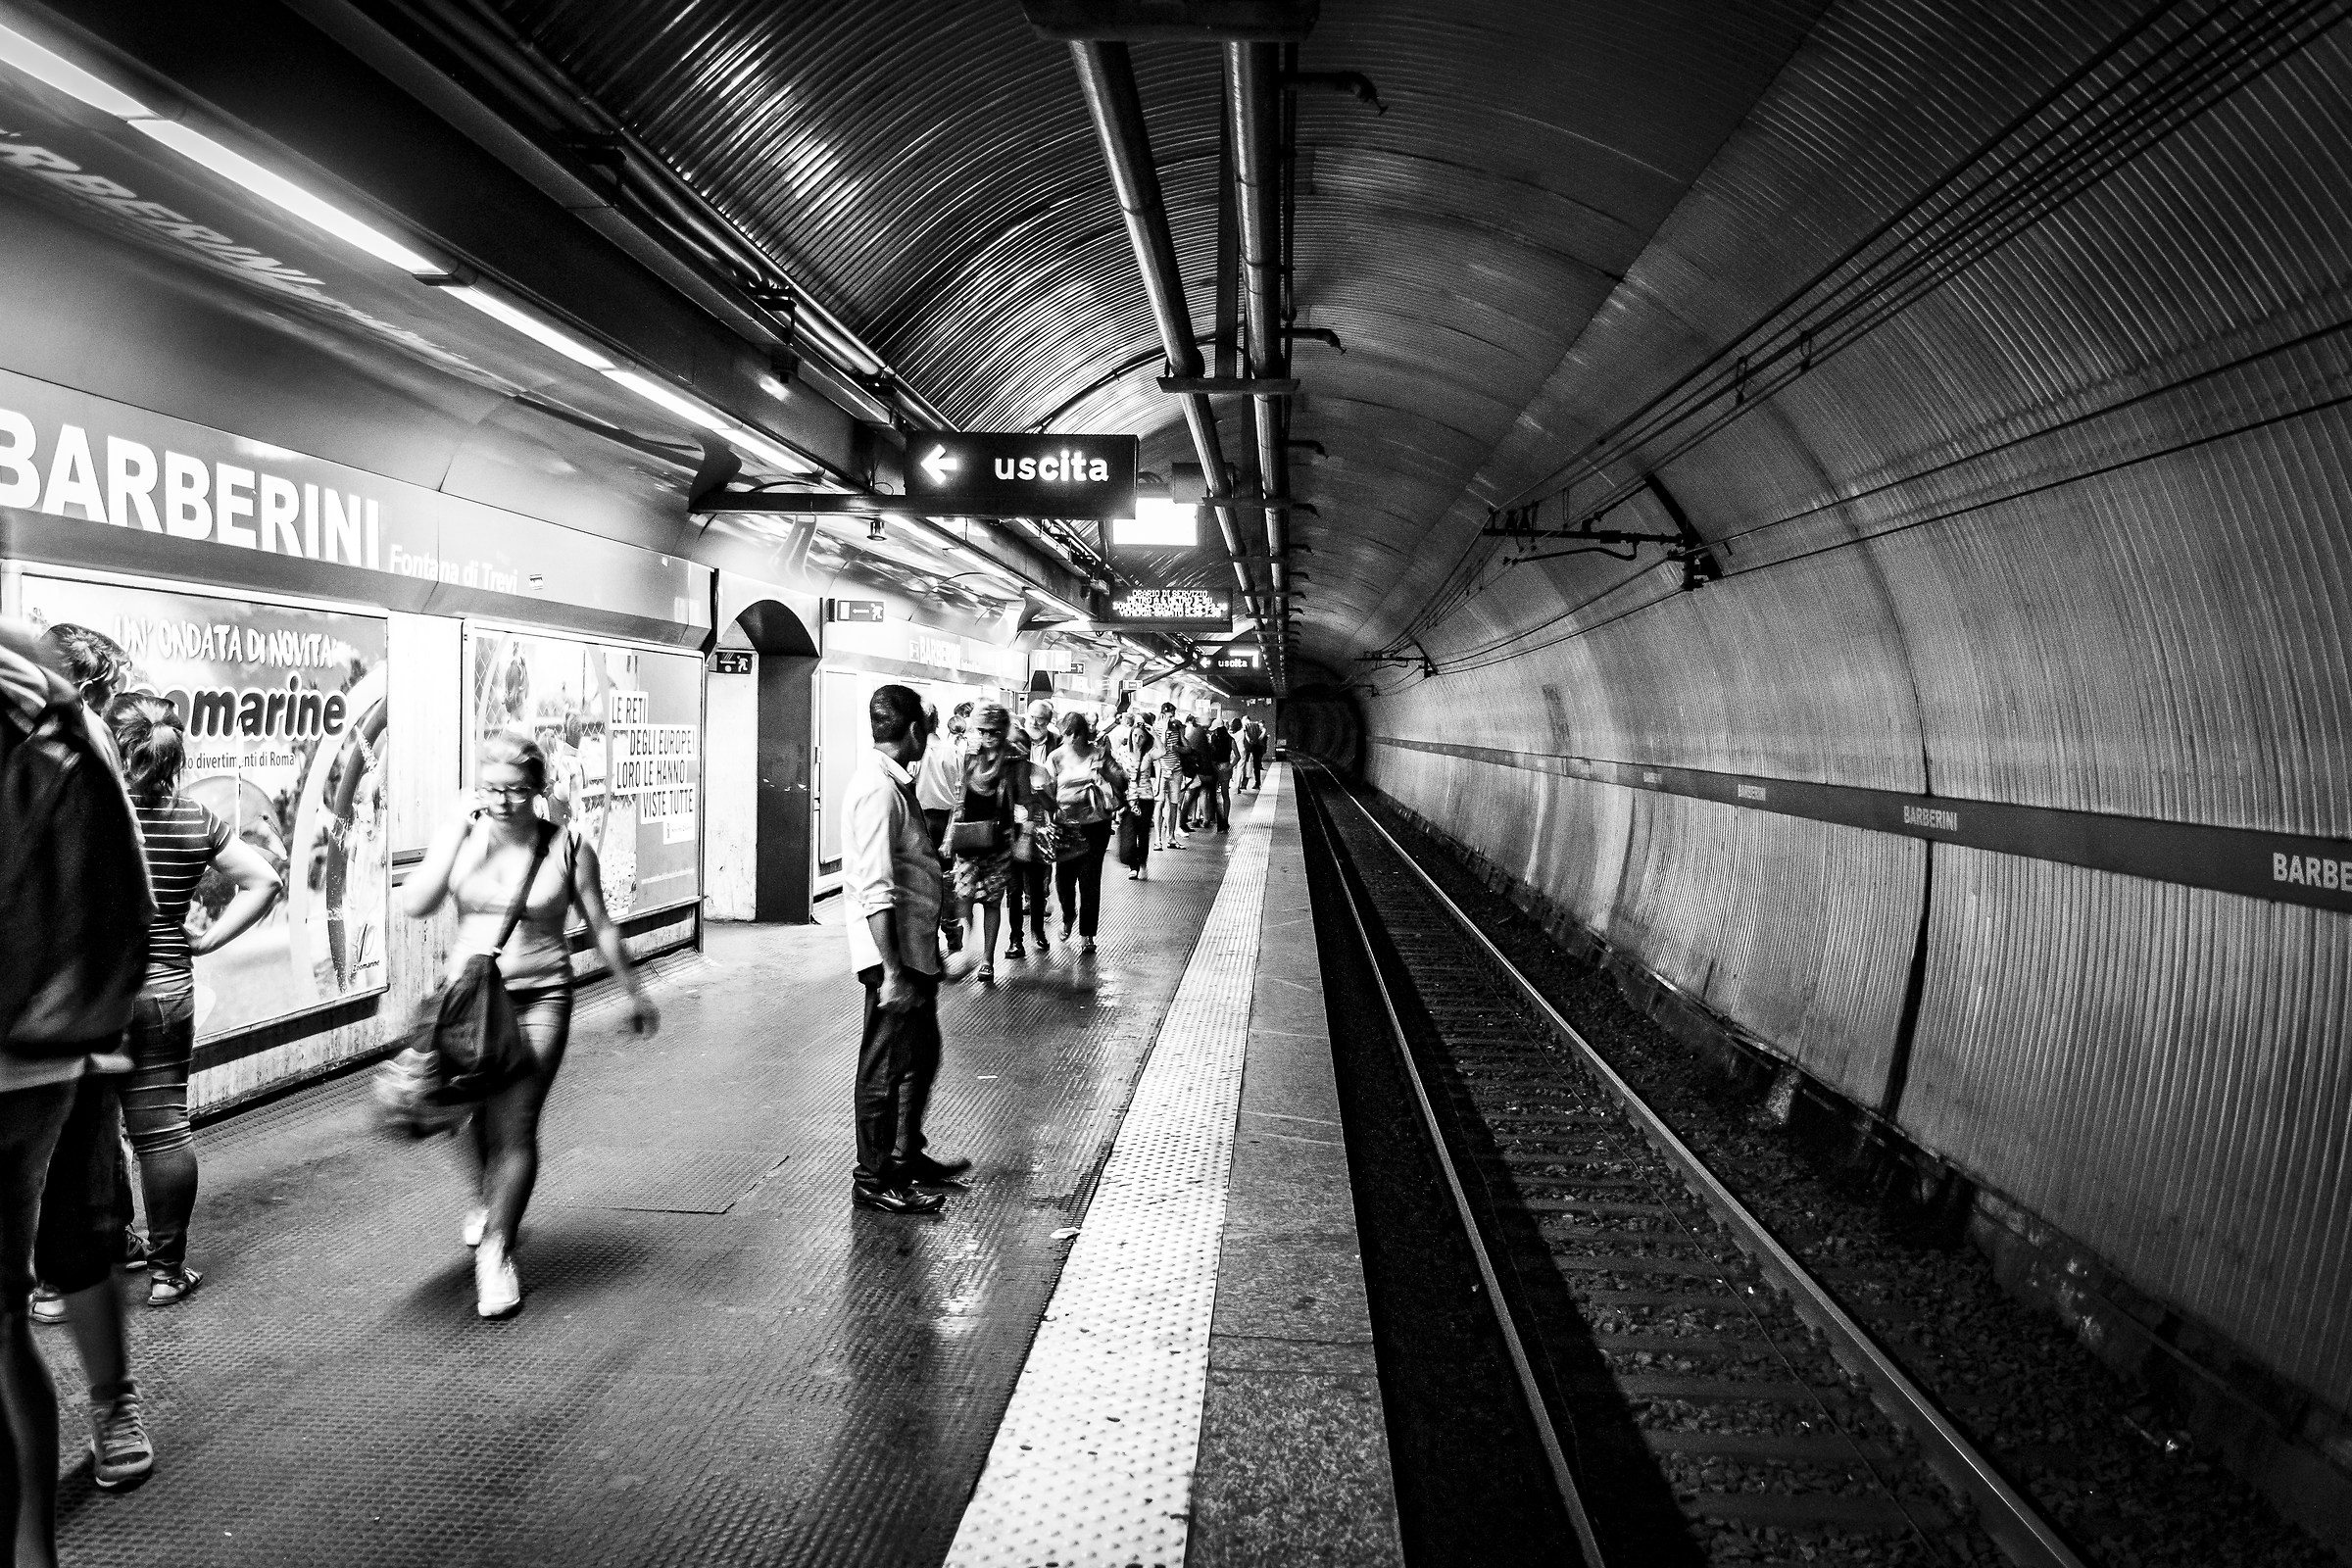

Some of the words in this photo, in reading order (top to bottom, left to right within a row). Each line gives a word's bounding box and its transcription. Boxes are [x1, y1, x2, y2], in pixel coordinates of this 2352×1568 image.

[995, 449, 1109, 481] uscita
[0, 408, 379, 570] BARBERINI
[390, 543, 459, 584] Fontana
[464, 559, 479, 588] di
[482, 563, 518, 595] Trevi
[158, 618, 243, 662] ONDATA
[247, 627, 267, 664] DI
[1218, 659, 1248, 667] uscita
[612, 697, 622, 724] LE
[625, 697, 647, 724] RETI
[630, 729, 656, 756] DEGLI
[659, 729, 695, 755] EUROPEI
[196, 752, 258, 769] divertimnti
[259, 752, 268, 767] di
[270, 751, 295, 766] Roma
[616, 760, 641, 789] LORO
[644, 760, 654, 786] LE
[657, 760, 685, 785] HANNO
[643, 790, 666, 817] VISTE
[669, 789, 693, 814] TUTTE
[1903, 806, 1958, 831] BARBERINI
